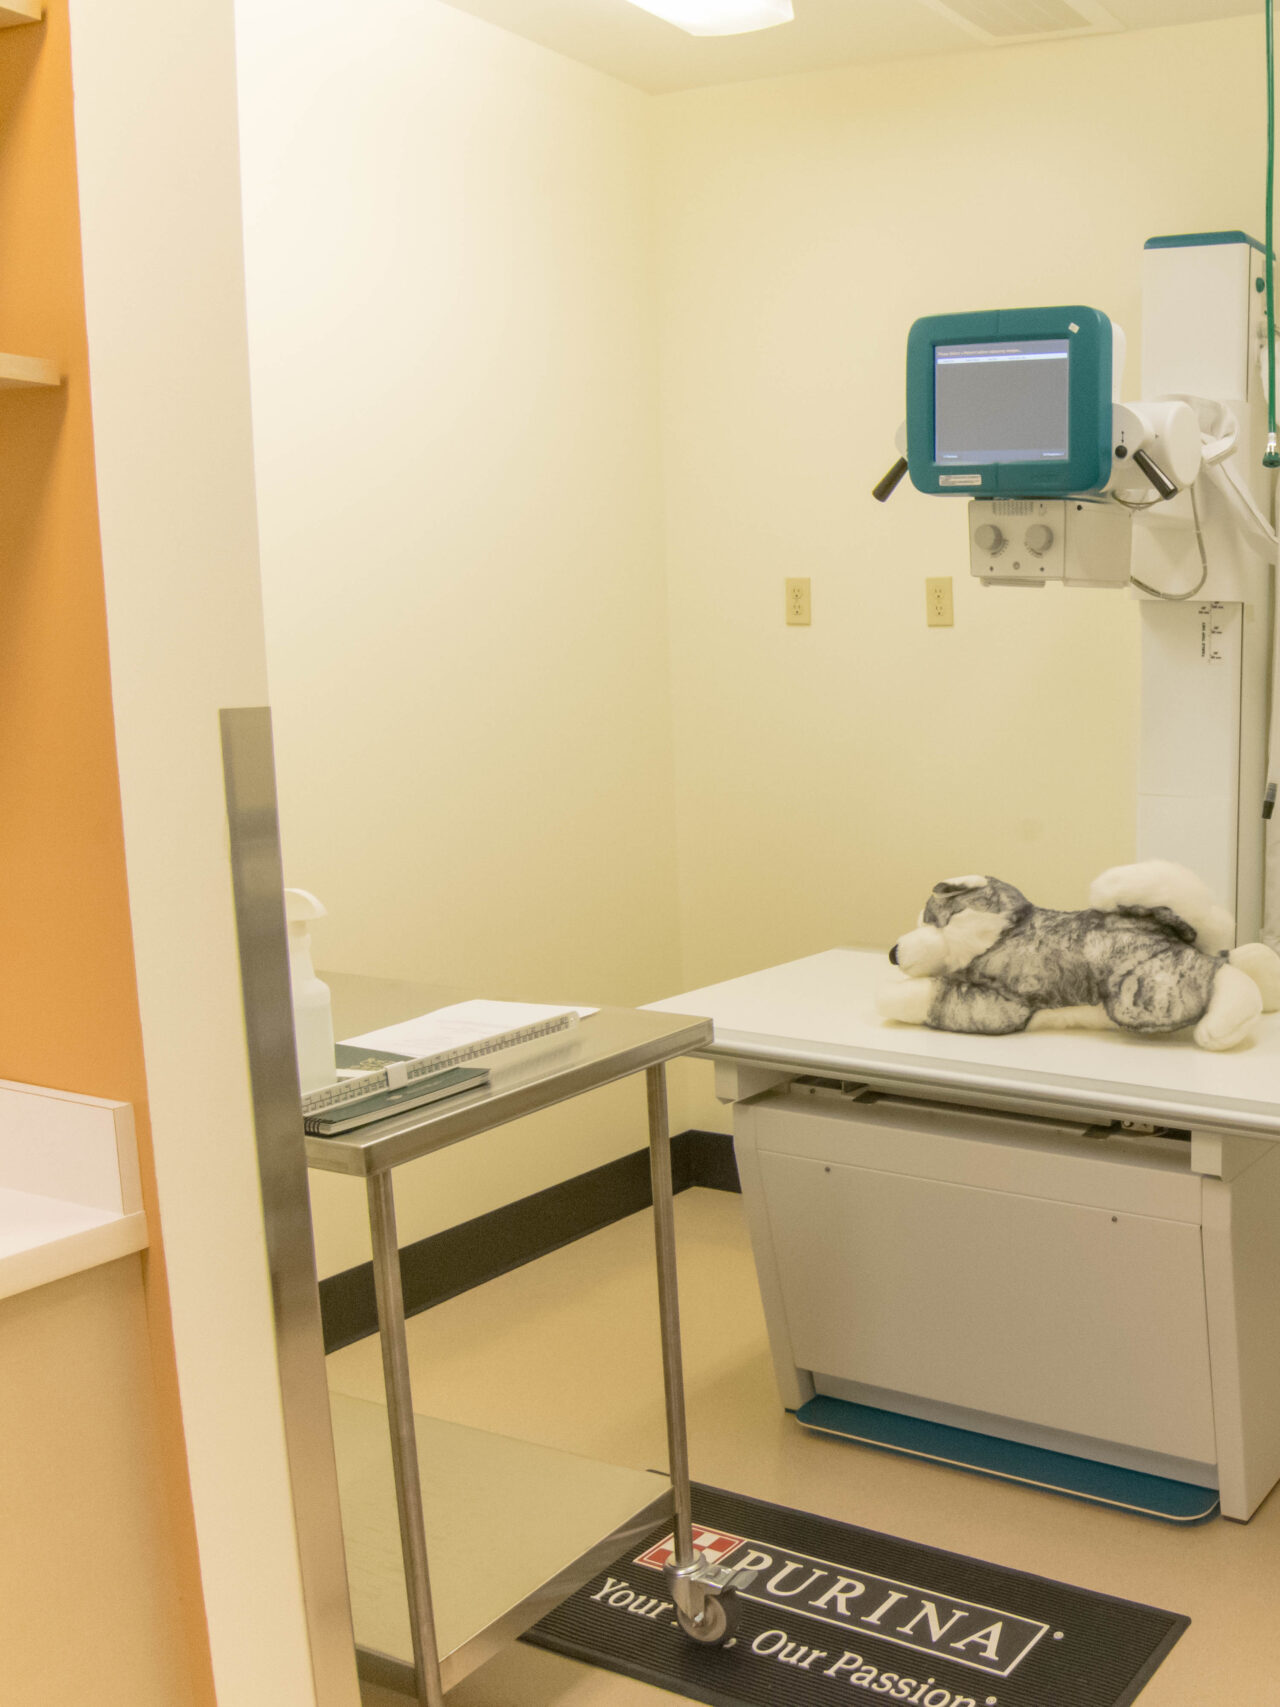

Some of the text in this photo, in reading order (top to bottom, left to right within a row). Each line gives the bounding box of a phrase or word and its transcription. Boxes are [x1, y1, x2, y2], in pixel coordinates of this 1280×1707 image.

[590, 1577, 674, 1619] Your
[752, 1629, 828, 1669] Our
[732, 1549, 1003, 1661] PURINA
